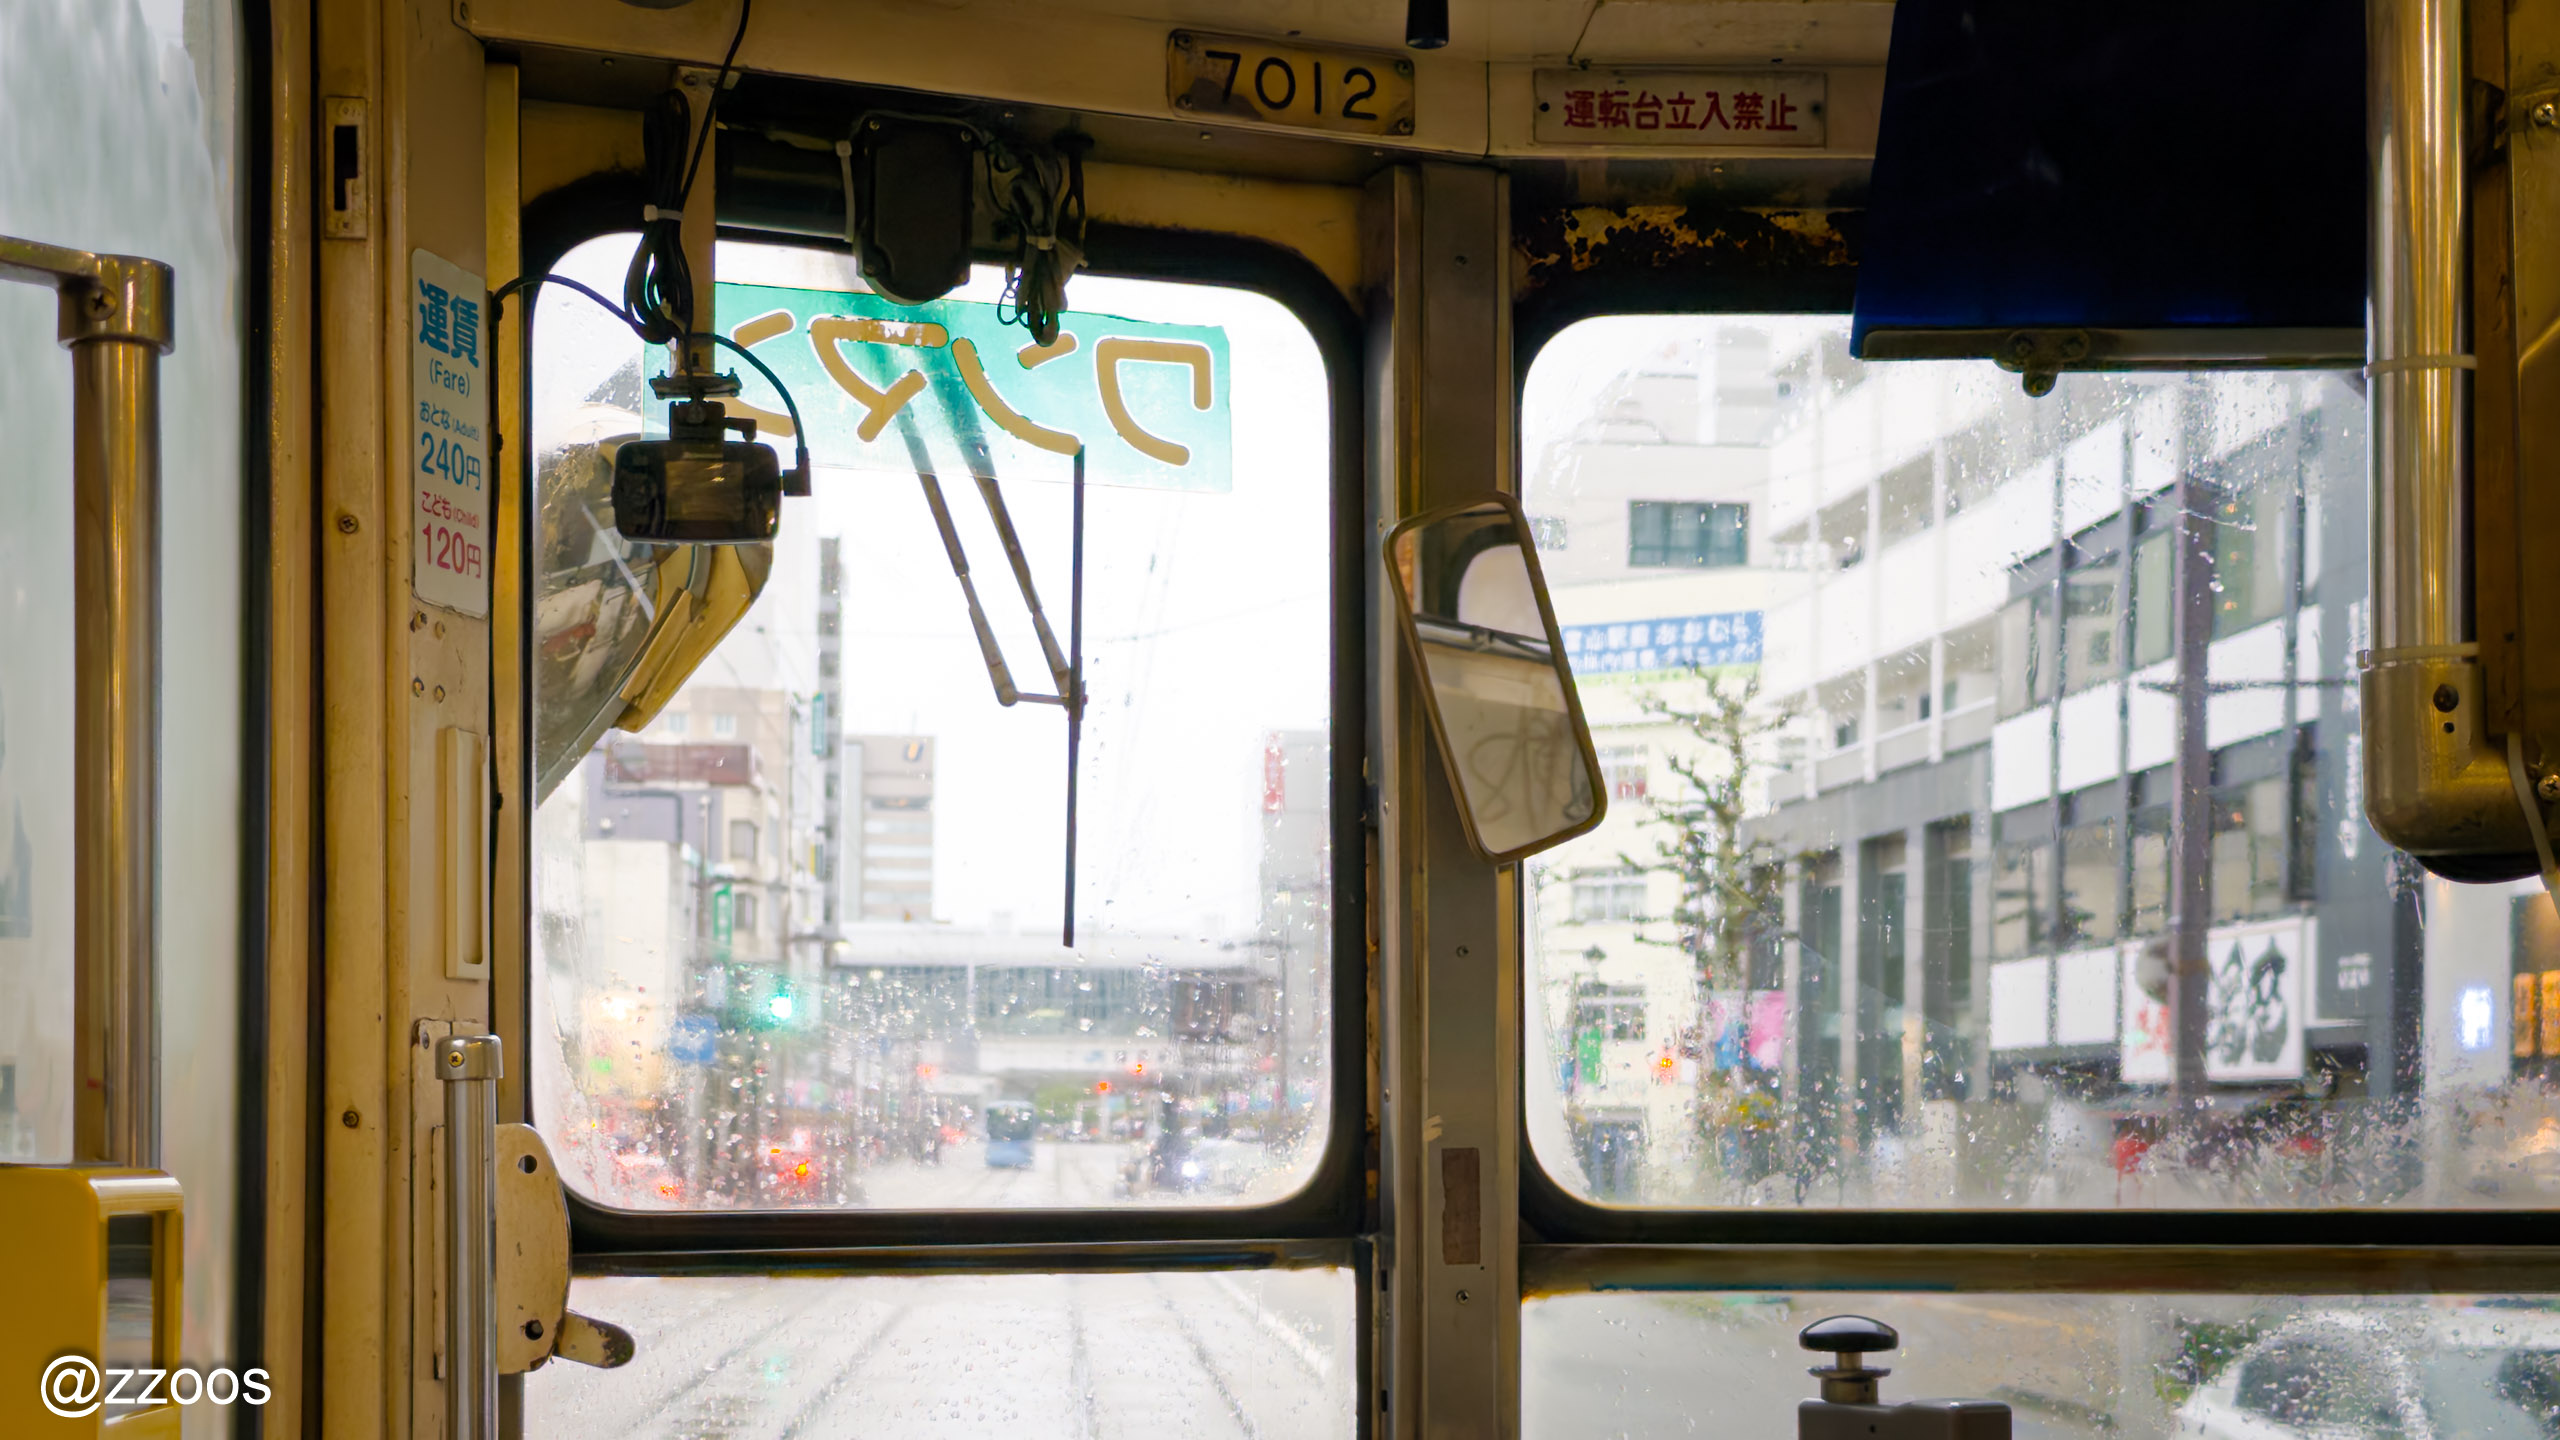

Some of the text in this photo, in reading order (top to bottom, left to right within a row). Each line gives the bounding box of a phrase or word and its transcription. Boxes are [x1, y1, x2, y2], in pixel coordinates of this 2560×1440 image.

[1204, 50, 1378, 121] 7012
[1563, 90, 1799, 131] 運転台立入禁止
[418, 277, 480, 369] 運賃
[429, 357, 471, 398] (Fare)
[420, 431, 481, 491] 240円
[422, 522, 482, 579] 120円
